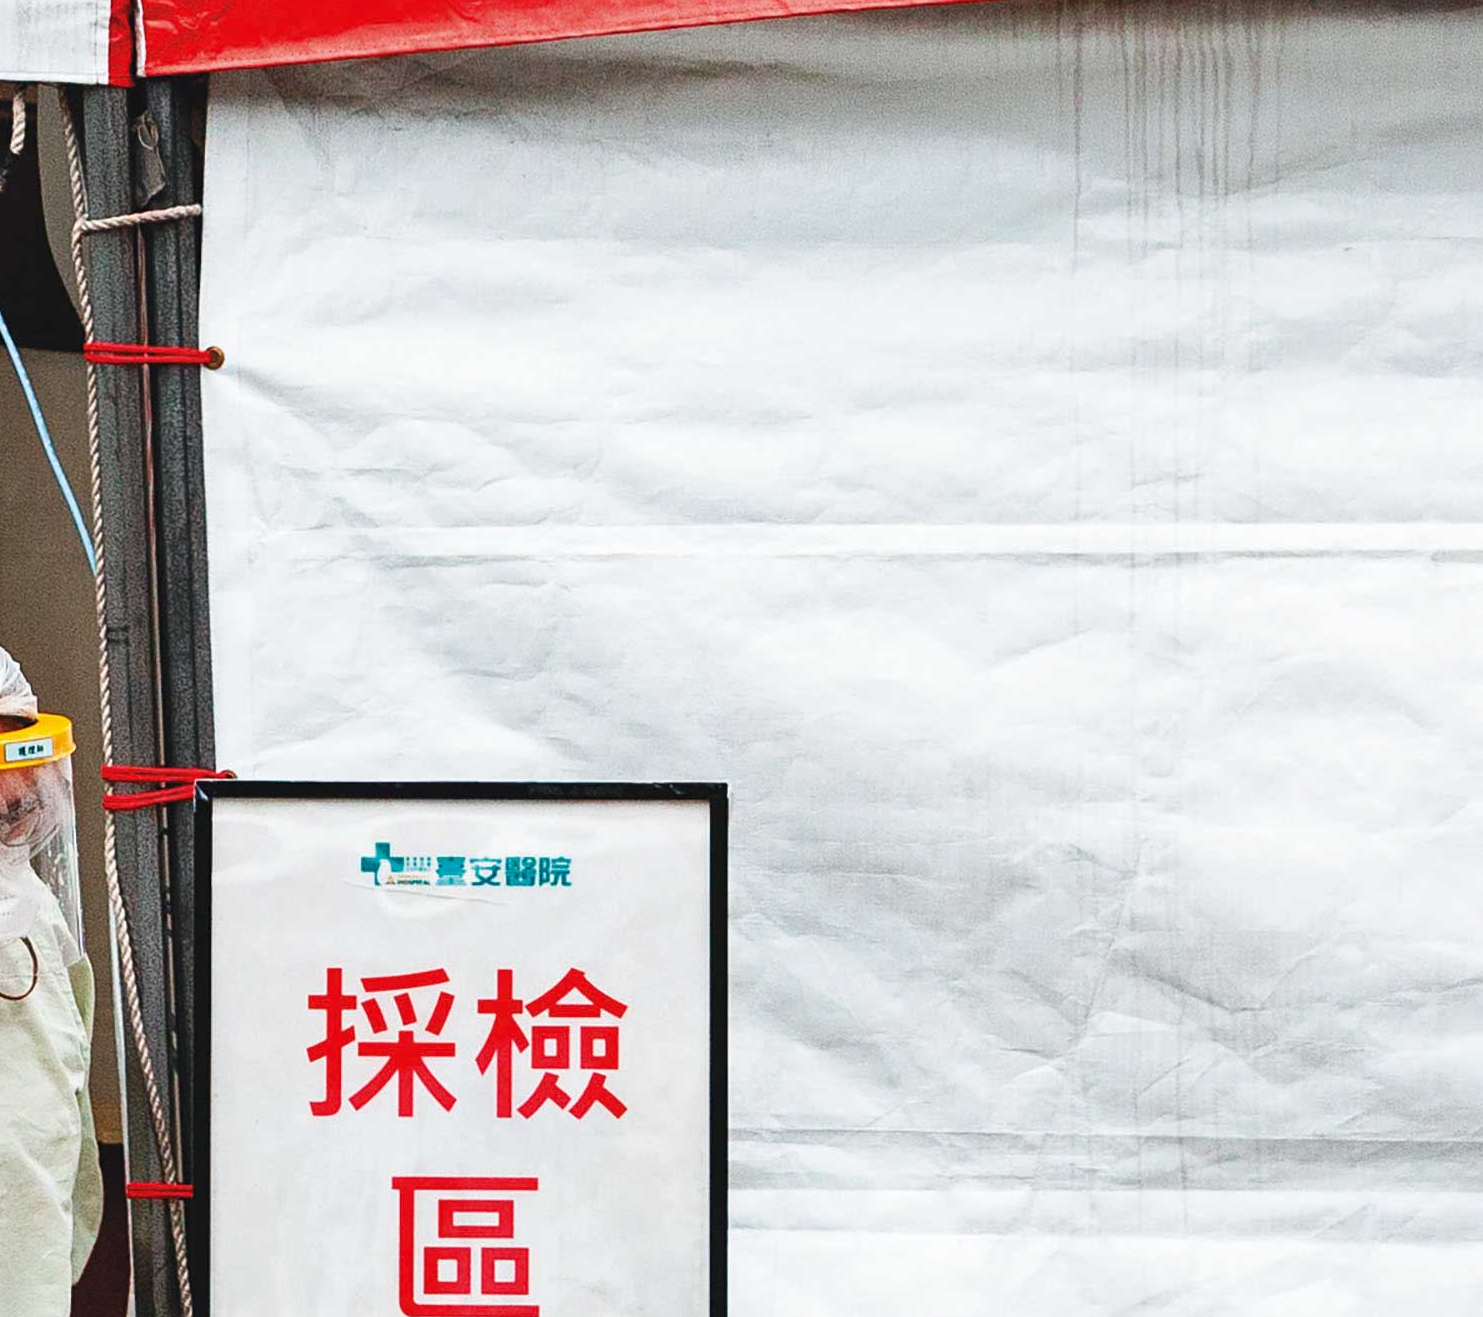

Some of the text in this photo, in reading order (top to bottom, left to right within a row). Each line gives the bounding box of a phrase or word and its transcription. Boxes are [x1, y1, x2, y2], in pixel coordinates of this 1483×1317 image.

[435, 855, 573, 888] 臺安醫院
[306, 967, 628, 1120] 採檢
